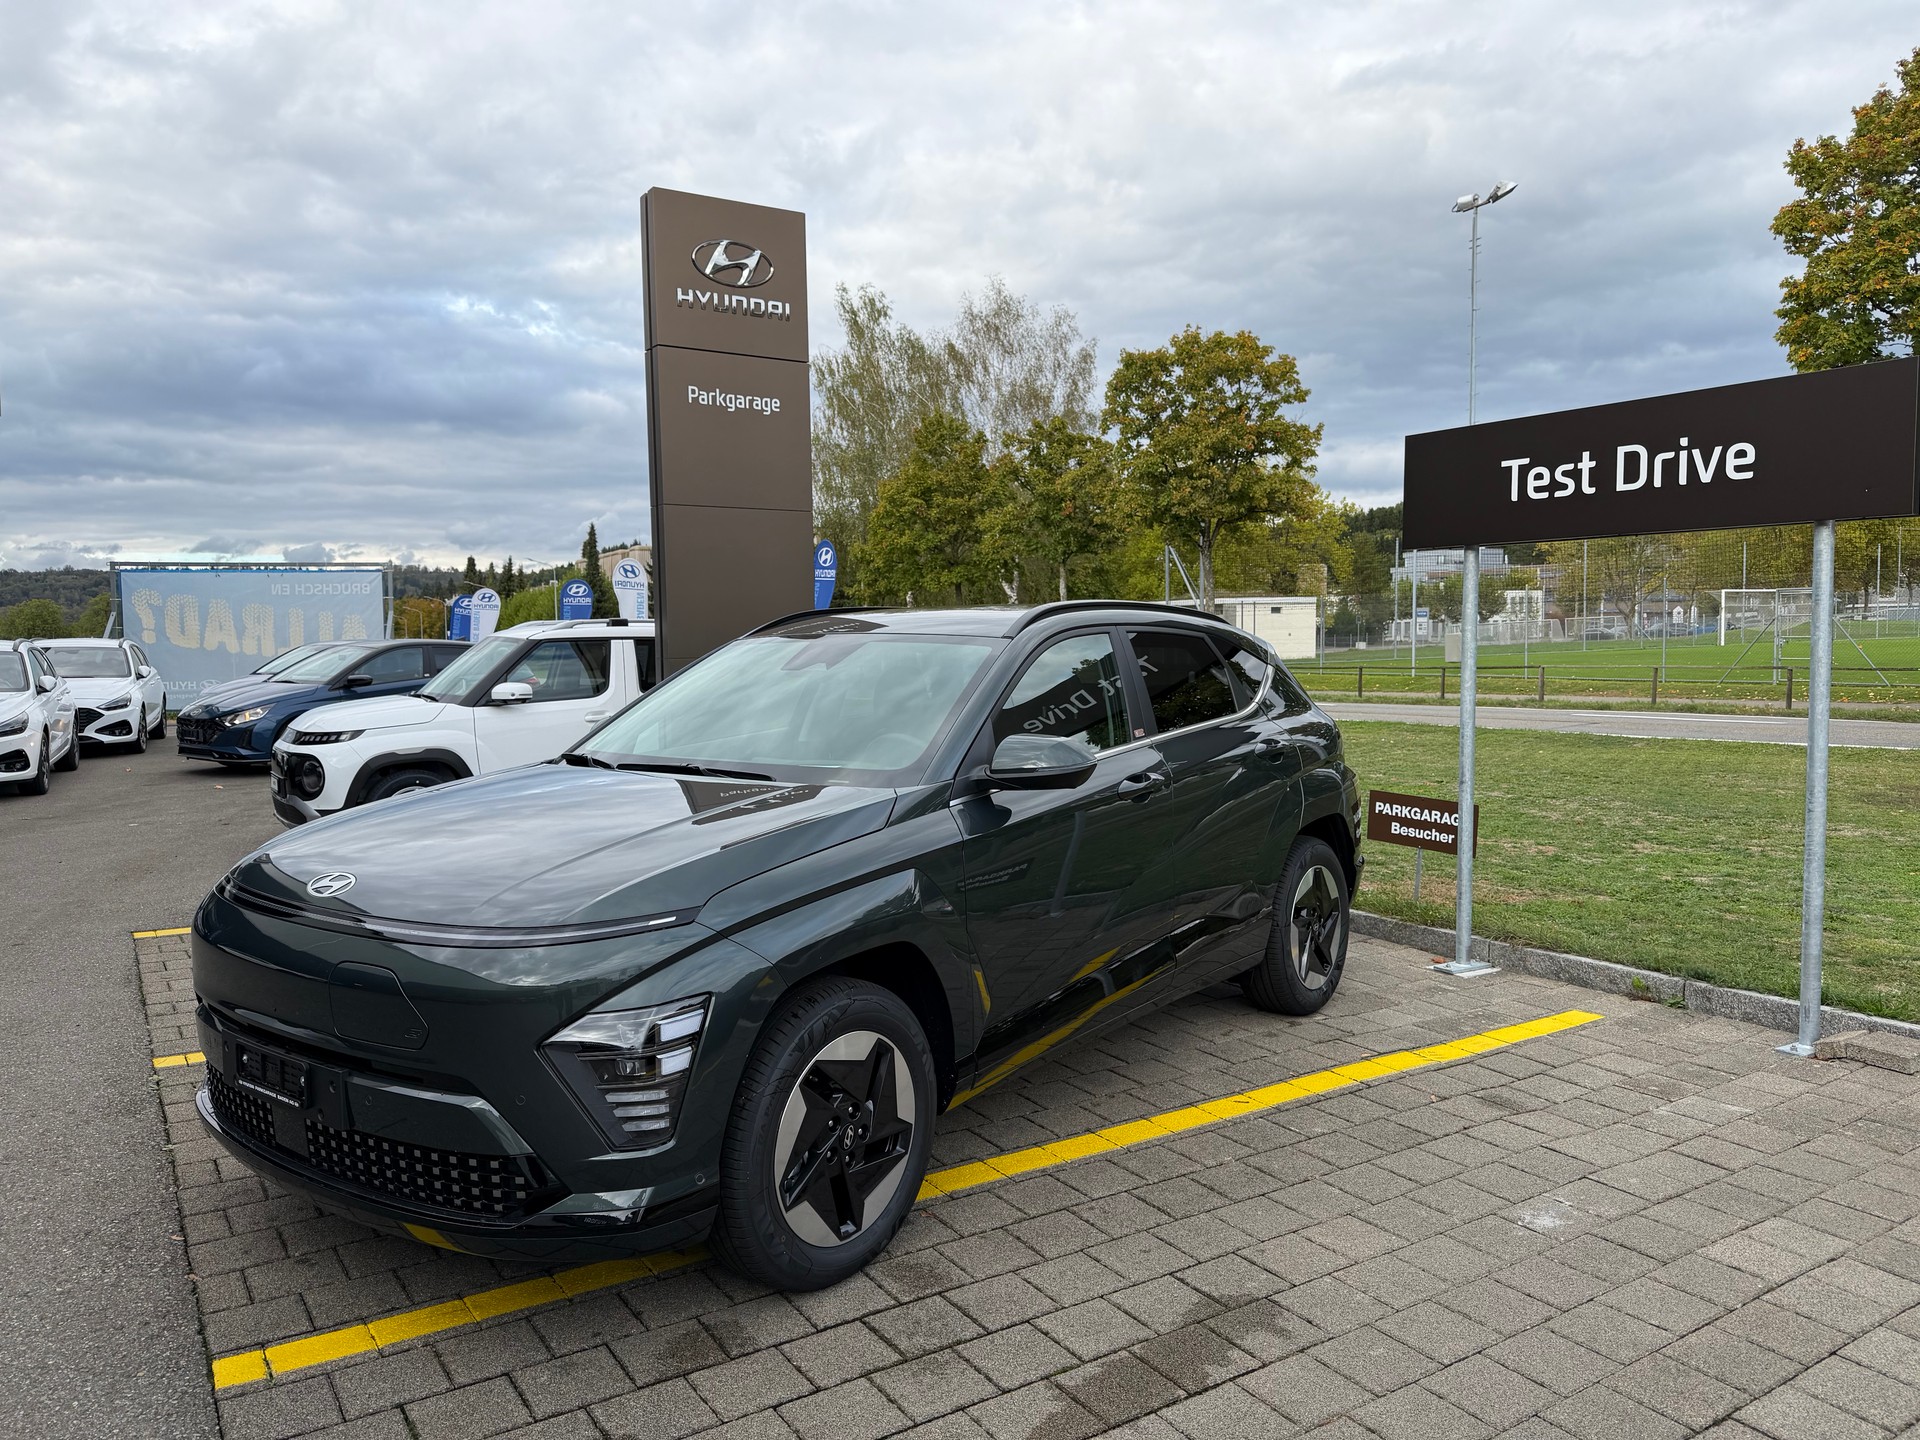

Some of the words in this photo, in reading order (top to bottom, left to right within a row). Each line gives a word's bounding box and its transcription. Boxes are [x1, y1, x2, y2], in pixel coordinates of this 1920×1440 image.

[676, 287, 791, 322] HYUNDAI
[687, 385, 781, 415] Parkgarage
[1501, 450, 1597, 502] Test
[1616, 437, 1756, 492] Drive
[454, 607, 471, 615] HYUN
[1375, 801, 1458, 826] PARKGARAG
[1390, 821, 1455, 844] Besucher
